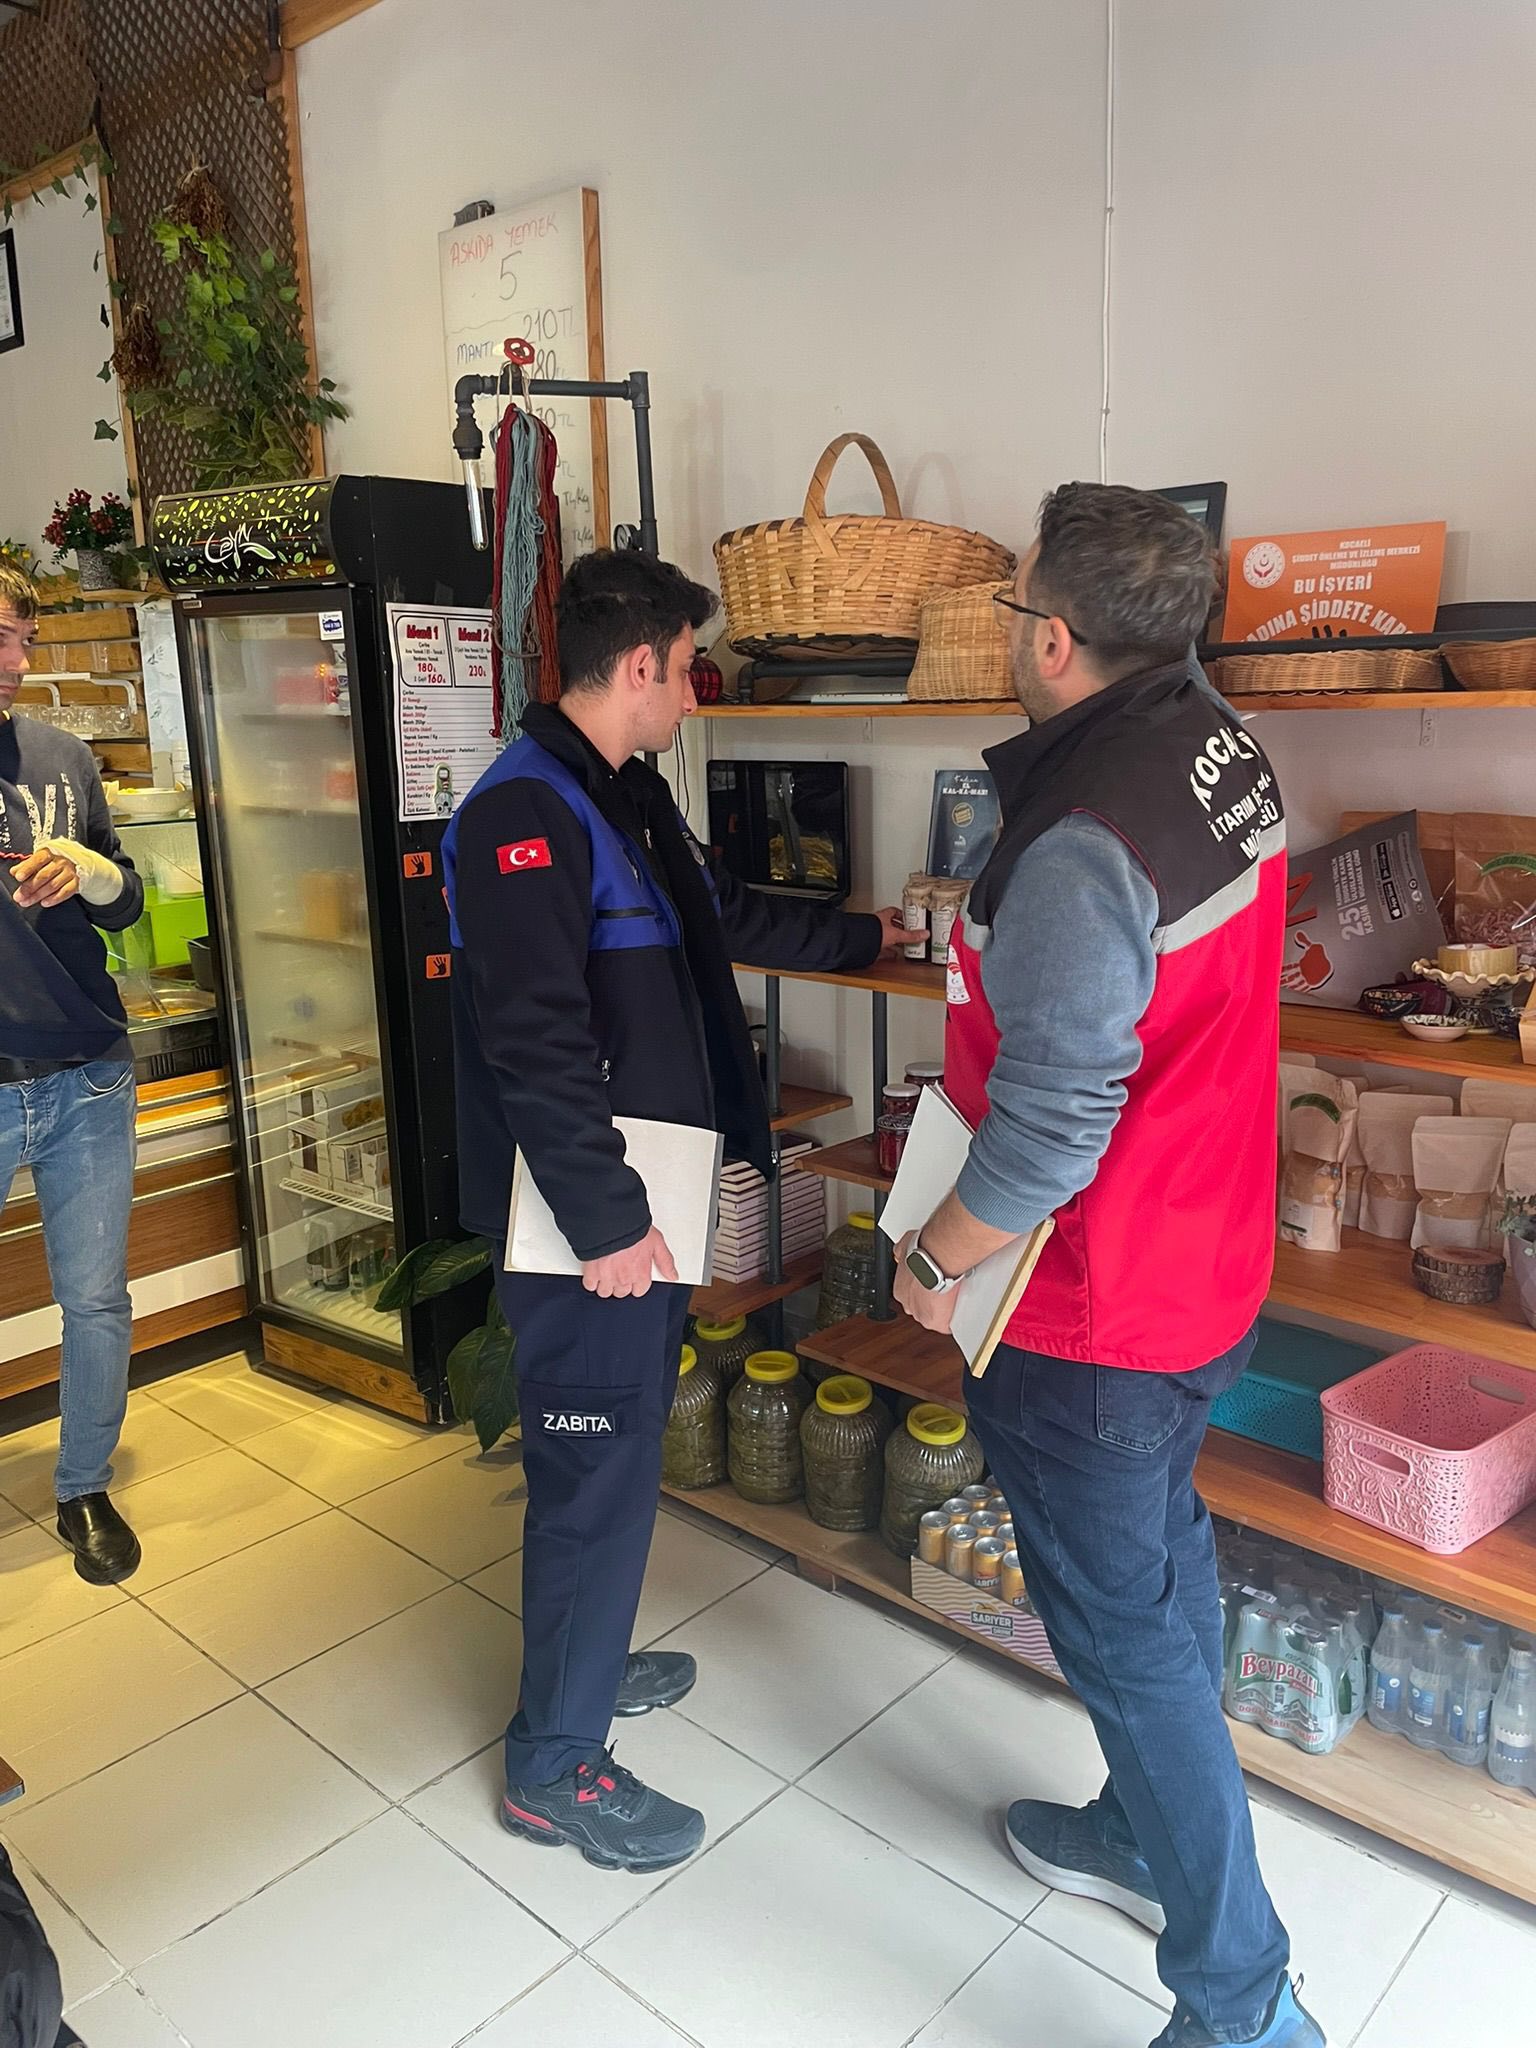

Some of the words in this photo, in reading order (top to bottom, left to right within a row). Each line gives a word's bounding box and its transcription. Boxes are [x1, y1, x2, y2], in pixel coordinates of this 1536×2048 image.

[450, 234, 494, 268] ASKIDA
[504, 212, 559, 248] YEMEK
[499, 250, 522, 301] 5
[1293, 578, 1316, 594] BU
[1318, 571, 1373, 595] İŞYERİ
[1242, 609, 1298, 642] ADINA
[1300, 598, 1374, 626] ŞİDDETE
[1215, 795, 1258, 835] TARIM
[1338, 907, 1365, 941] 25
[1359, 904, 1375, 934] KASIM
[543, 1413, 613, 1433] ZABITA
[972, 1612, 1012, 1628] SARIYER
[1240, 1652, 1318, 1695] Beypazarı
